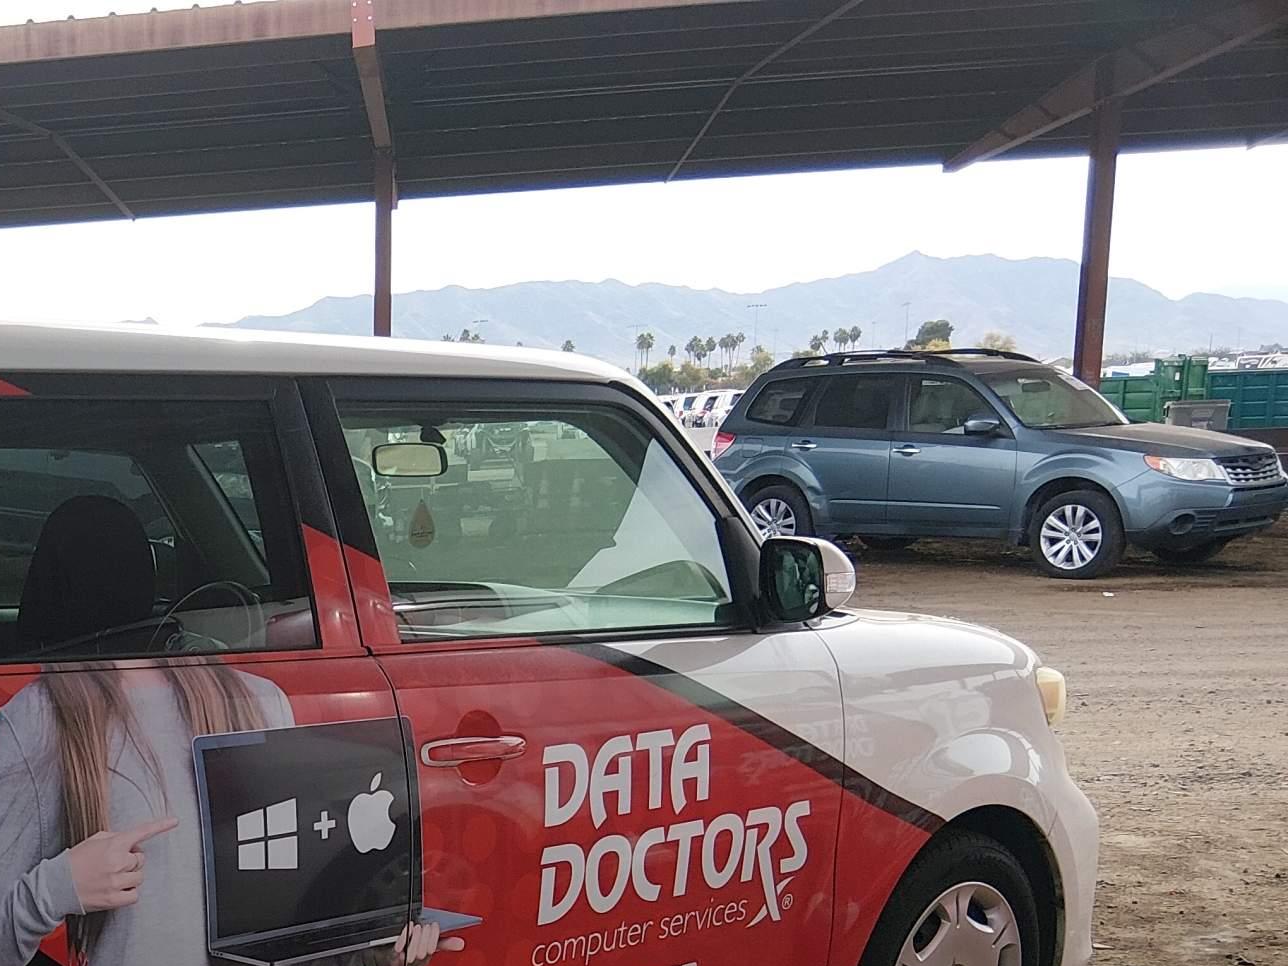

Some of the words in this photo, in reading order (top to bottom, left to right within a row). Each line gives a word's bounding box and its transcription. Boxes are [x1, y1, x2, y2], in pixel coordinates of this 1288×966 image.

[541, 723, 711, 829] DATA
[537, 800, 810, 927] DOCTORS
[531, 920, 655, 966] computer
[658, 896, 747, 939] services
